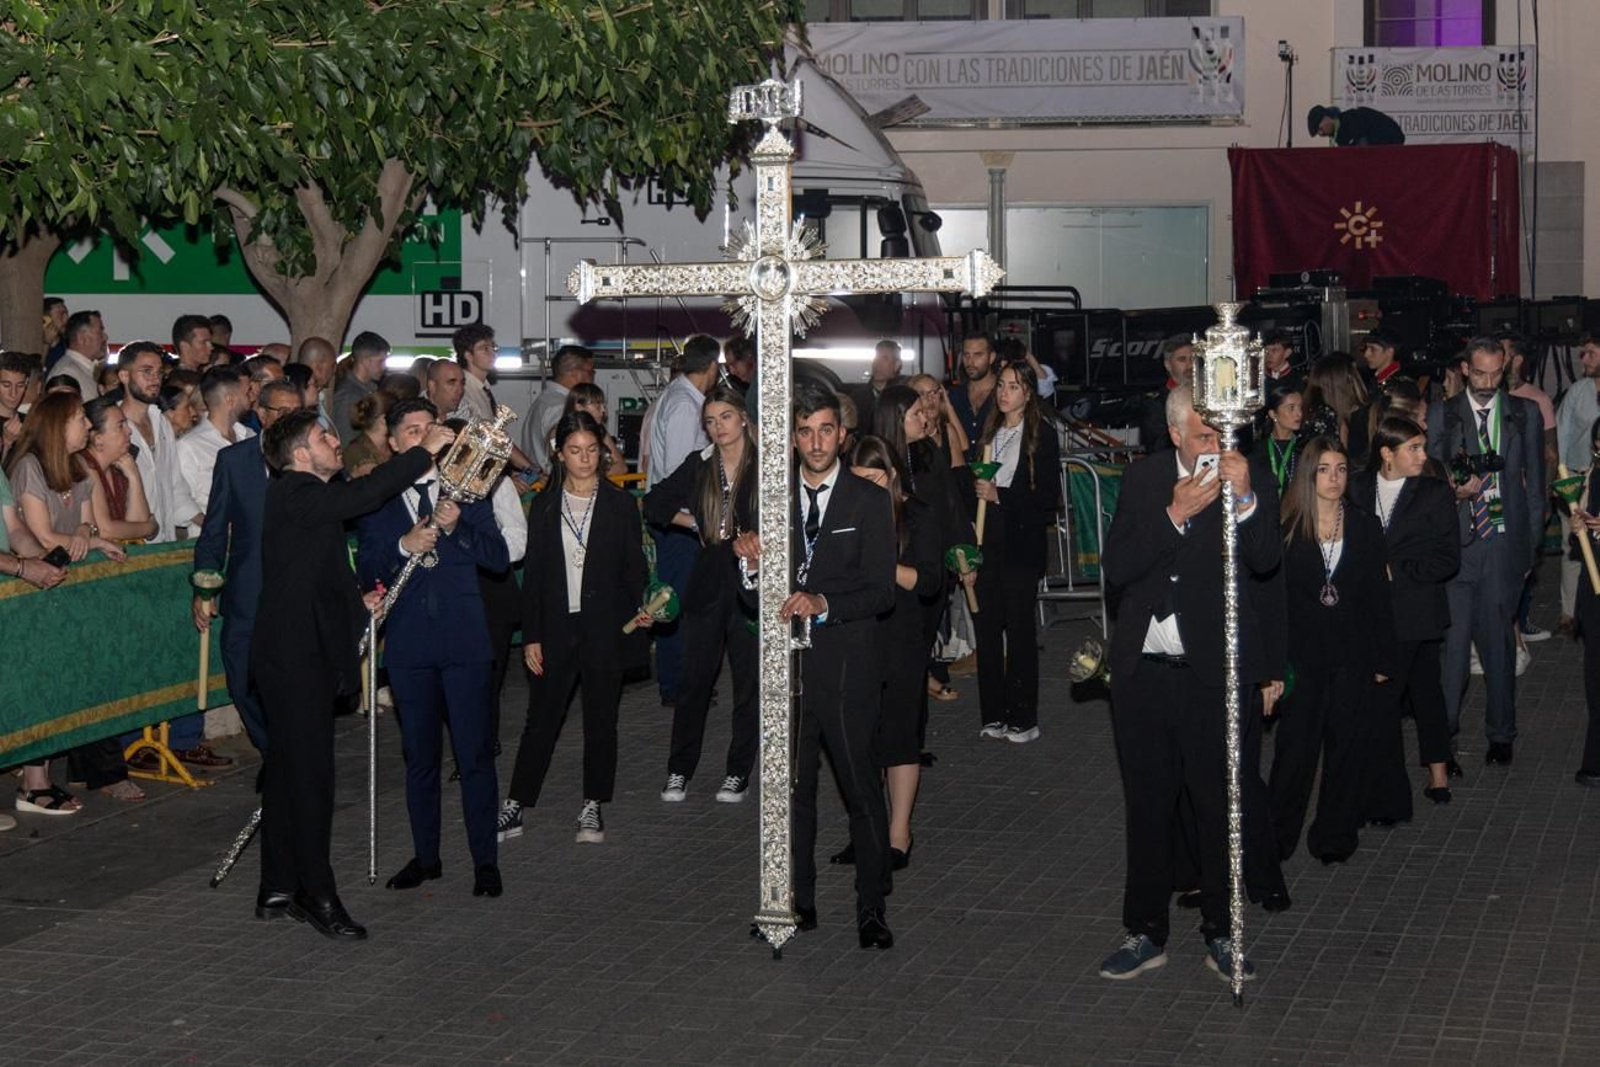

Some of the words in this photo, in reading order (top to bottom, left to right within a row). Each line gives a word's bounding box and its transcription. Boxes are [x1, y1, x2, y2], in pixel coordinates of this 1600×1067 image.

[904, 58, 940, 85] CON
[946, 57, 981, 84] LAS
[984, 55, 1104, 83] TRADICIONES
[1109, 55, 1133, 81] DE
[1136, 50, 1184, 81] JAÉN
[1416, 62, 1492, 83] MOLINO
[1398, 113, 1476, 132] TRADICIONES
[1479, 113, 1495, 131] DE
[424, 293, 480, 326] HD
